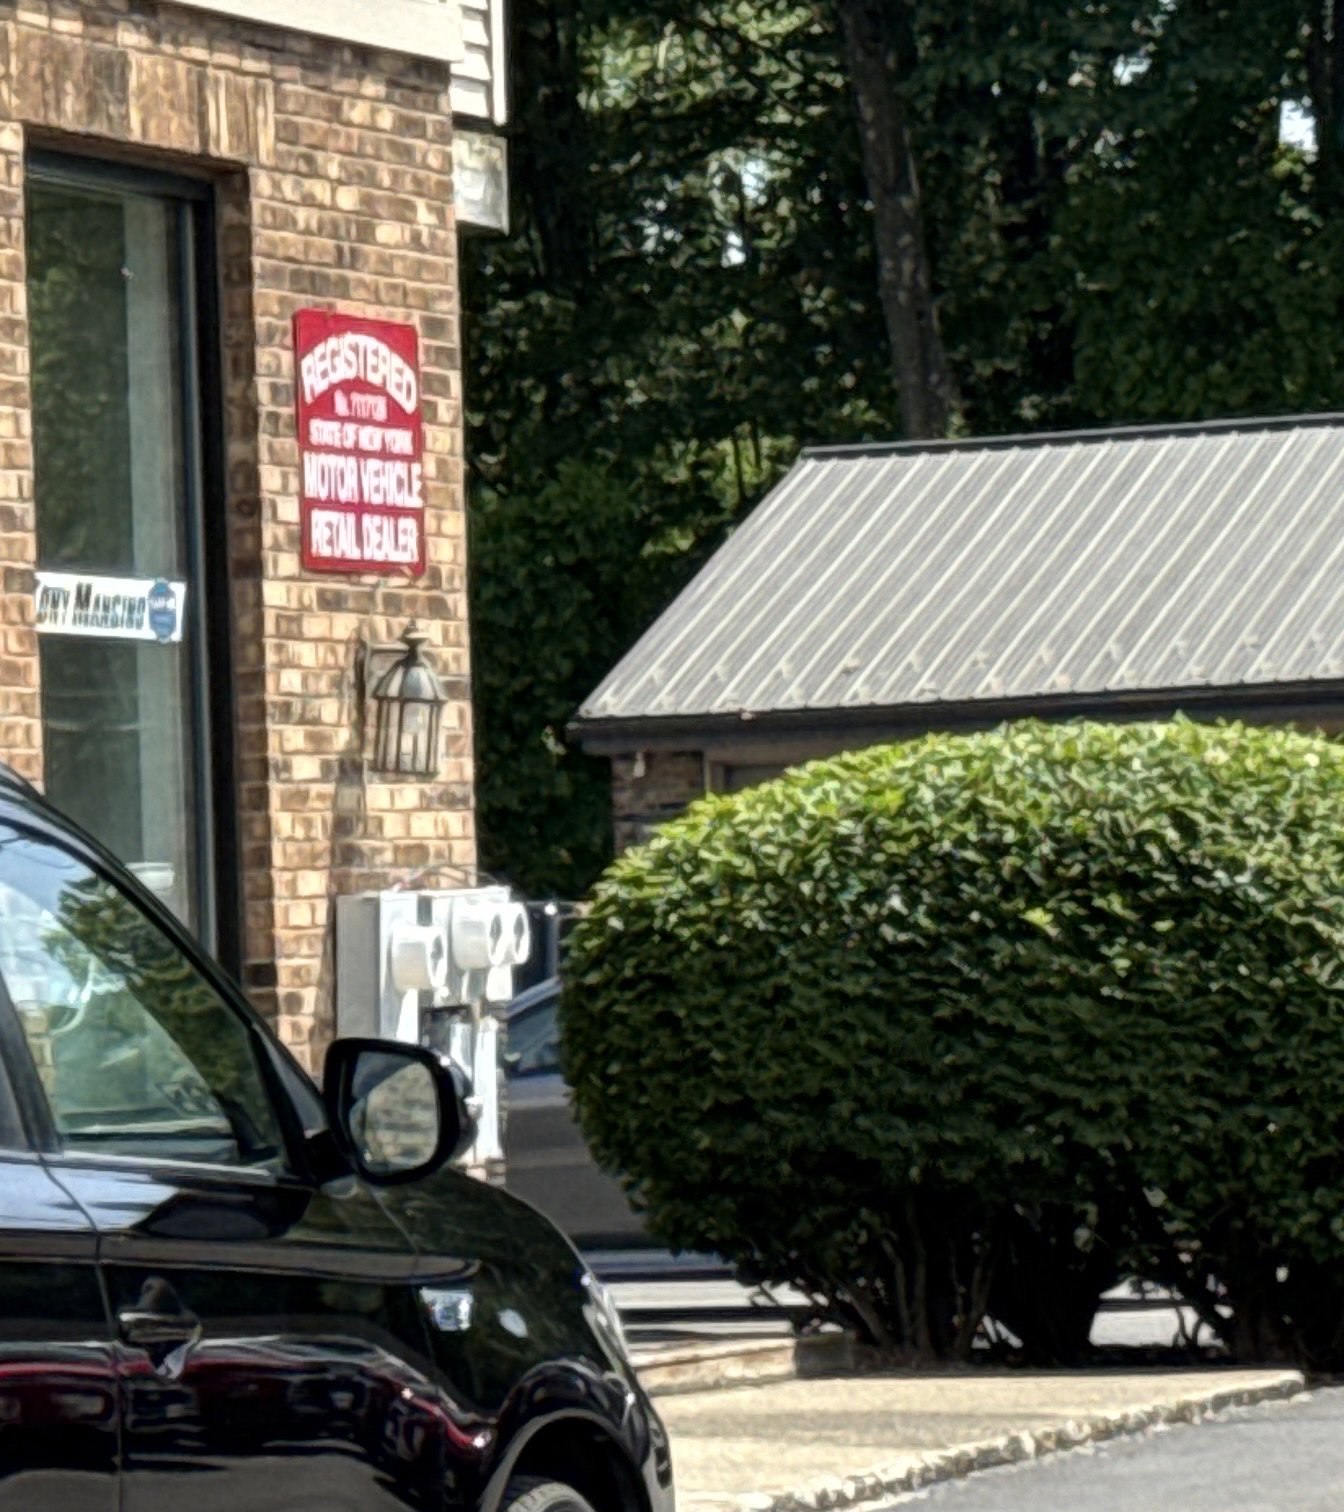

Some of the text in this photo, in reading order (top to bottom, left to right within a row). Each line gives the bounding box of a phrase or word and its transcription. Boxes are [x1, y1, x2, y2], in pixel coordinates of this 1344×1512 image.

[300, 331, 417, 416] REGISTERED
[303, 450, 423, 509] MOTOR VEHICLE
[310, 507, 419, 563] RETAIL DEALER
[36, 584, 71, 626] ONY
